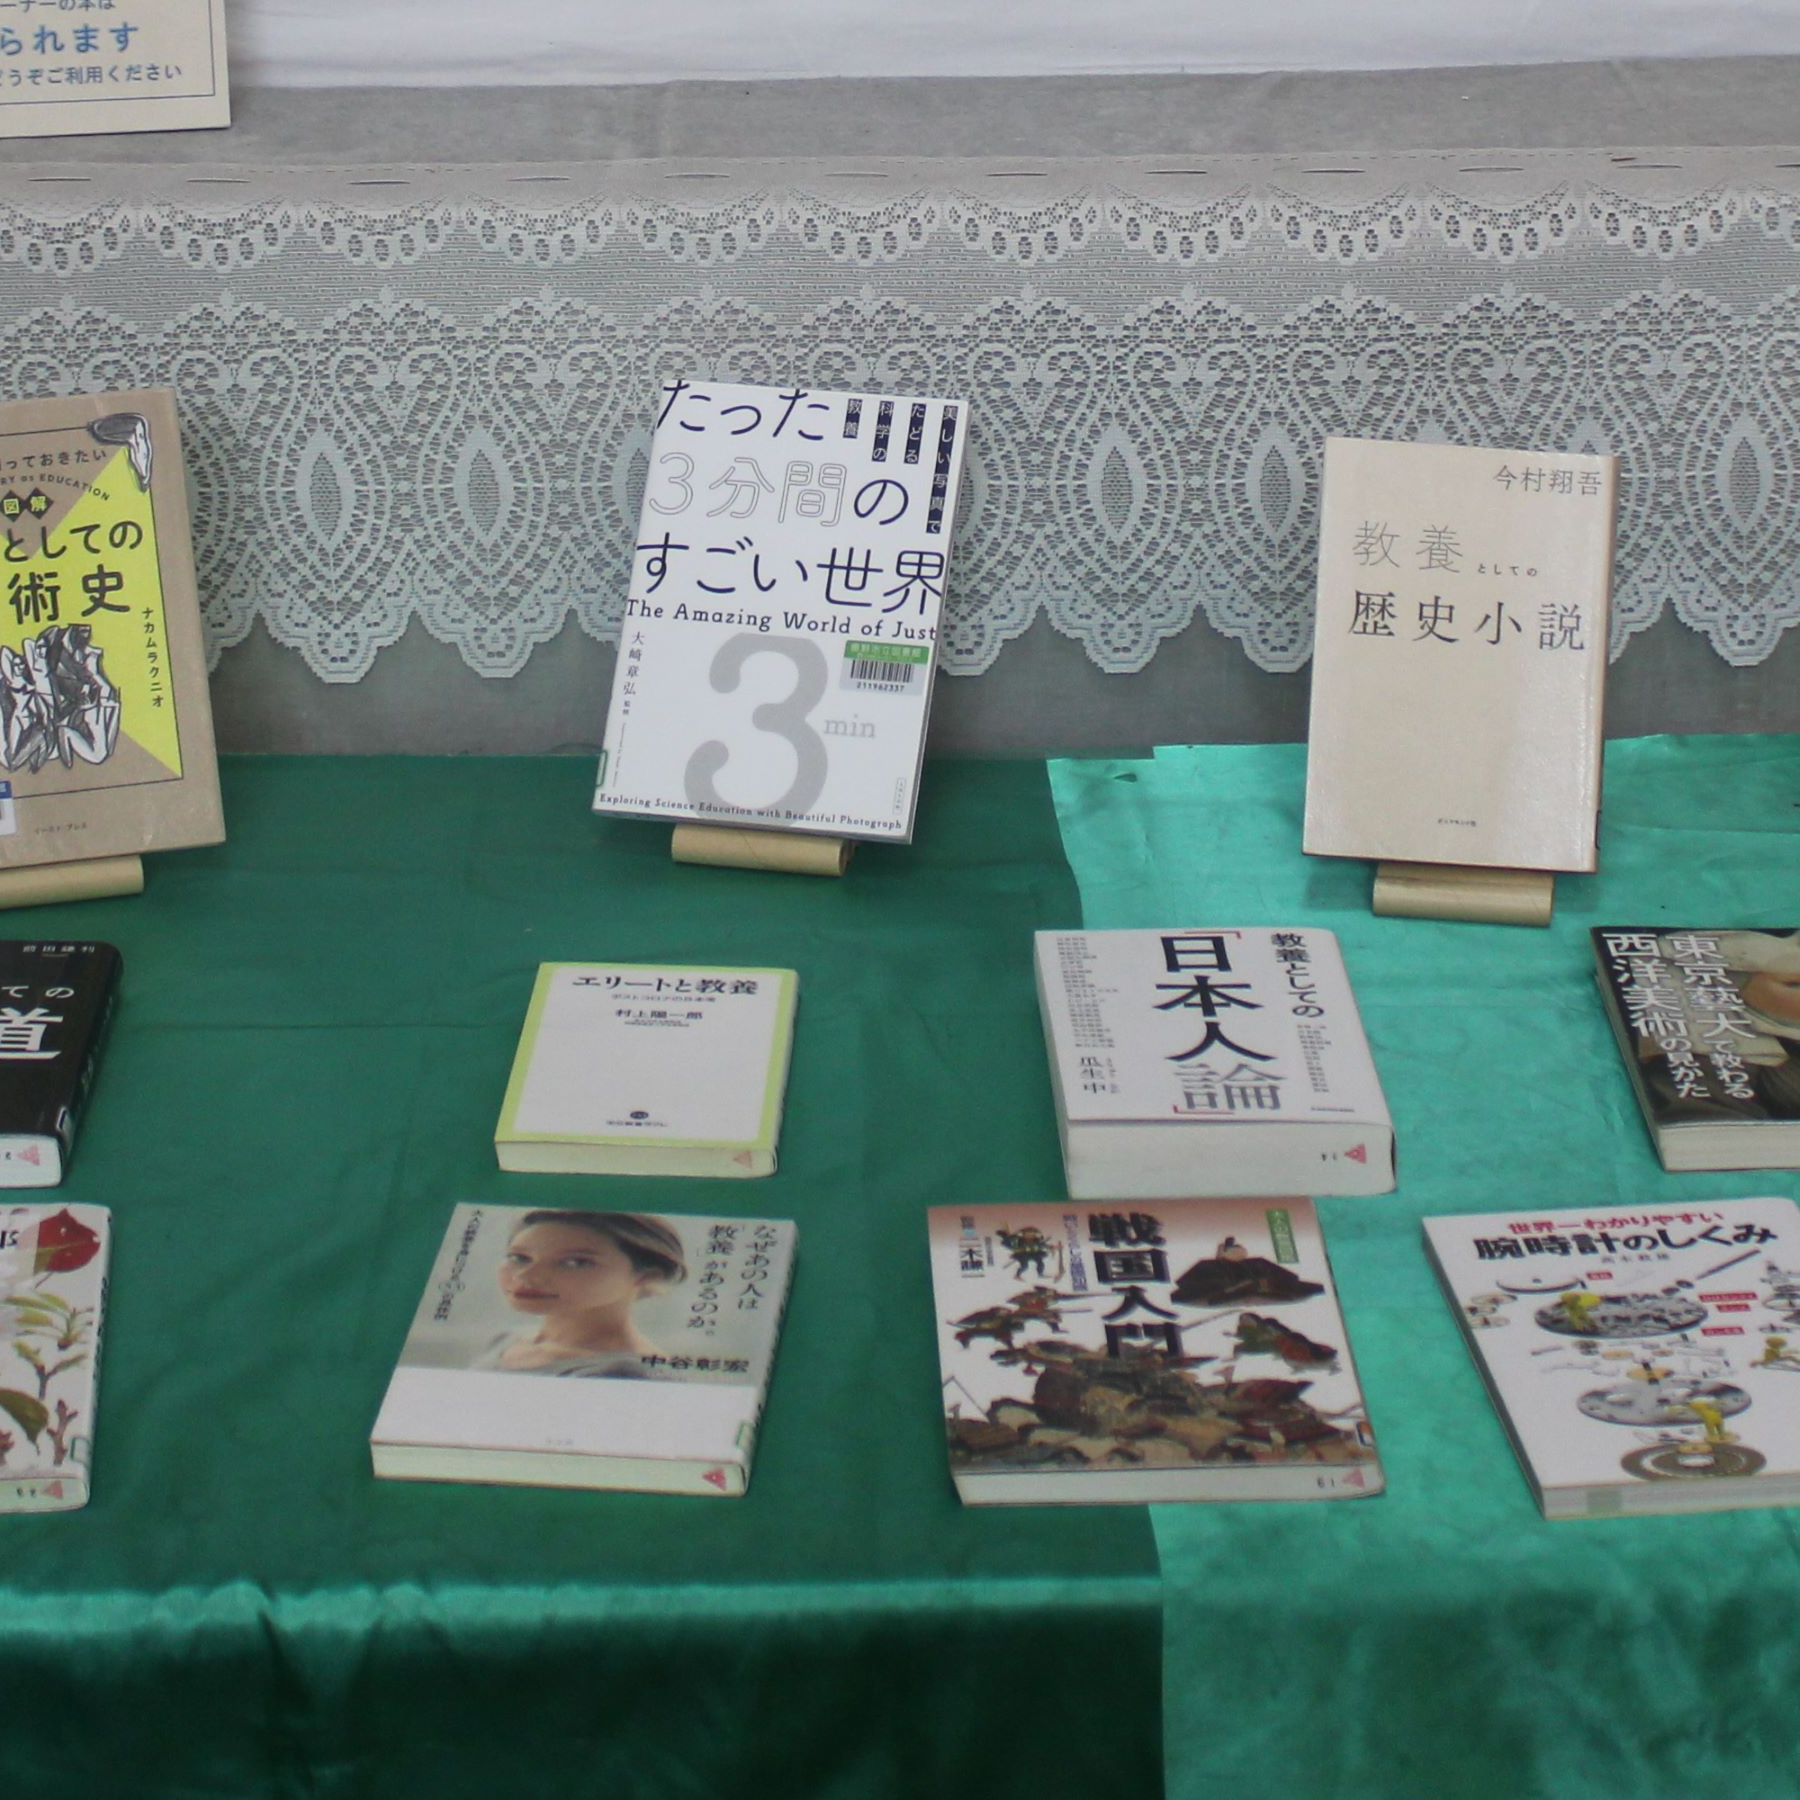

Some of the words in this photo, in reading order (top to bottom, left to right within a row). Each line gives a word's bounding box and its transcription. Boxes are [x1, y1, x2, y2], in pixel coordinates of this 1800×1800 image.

[657, 379, 830, 441] たった
[843, 398, 862, 439] 教養
[873, 400, 895, 463] 科学の
[904, 403, 927, 464] たどる
[20, 473, 35, 483] as
[38, 471, 111, 503] EDUCATION
[648, 450, 910, 528] 3分間の
[926, 404, 959, 534] 美しい写真で
[1493, 464, 1604, 496] 今村翔吾
[636, 532, 945, 616] すごい世界
[627, 599, 664, 620] The
[673, 603, 771, 631] Amazing
[783, 611, 851, 636] World
[861, 617, 884, 637] of
[892, 619, 938, 642] Just
[1349, 590, 1586, 651] 歴史小説
[141, 607, 165, 709] ナカムラクニオ
[684, 632, 829, 826] 3
[823, 713, 877, 739] min
[599, 793, 651, 808] Exploring
[655, 797, 695, 811] Science
[698, 802, 752, 816] Education
[757, 806, 781, 818] with
[785, 810, 836, 824] Beautiful
[840, 814, 902, 831] Photograph
[572, 976, 758, 996] エリートと教養
[1271, 932, 1325, 1018] 教養としての
[1602, 933, 1711, 1100] 西洋美術の見かた
[1666, 934, 1757, 1100] 東京藝大で教わる
[1473, 1223, 1778, 1261] 腕時計のしくみ
[1507, 1211, 1725, 1234] 世界一わかりやすい
[685, 1224, 737, 1337] 教養があるのか。
[736, 1224, 778, 1311] なぜあの人は
[640, 1354, 750, 1374] 中谷彰宏
